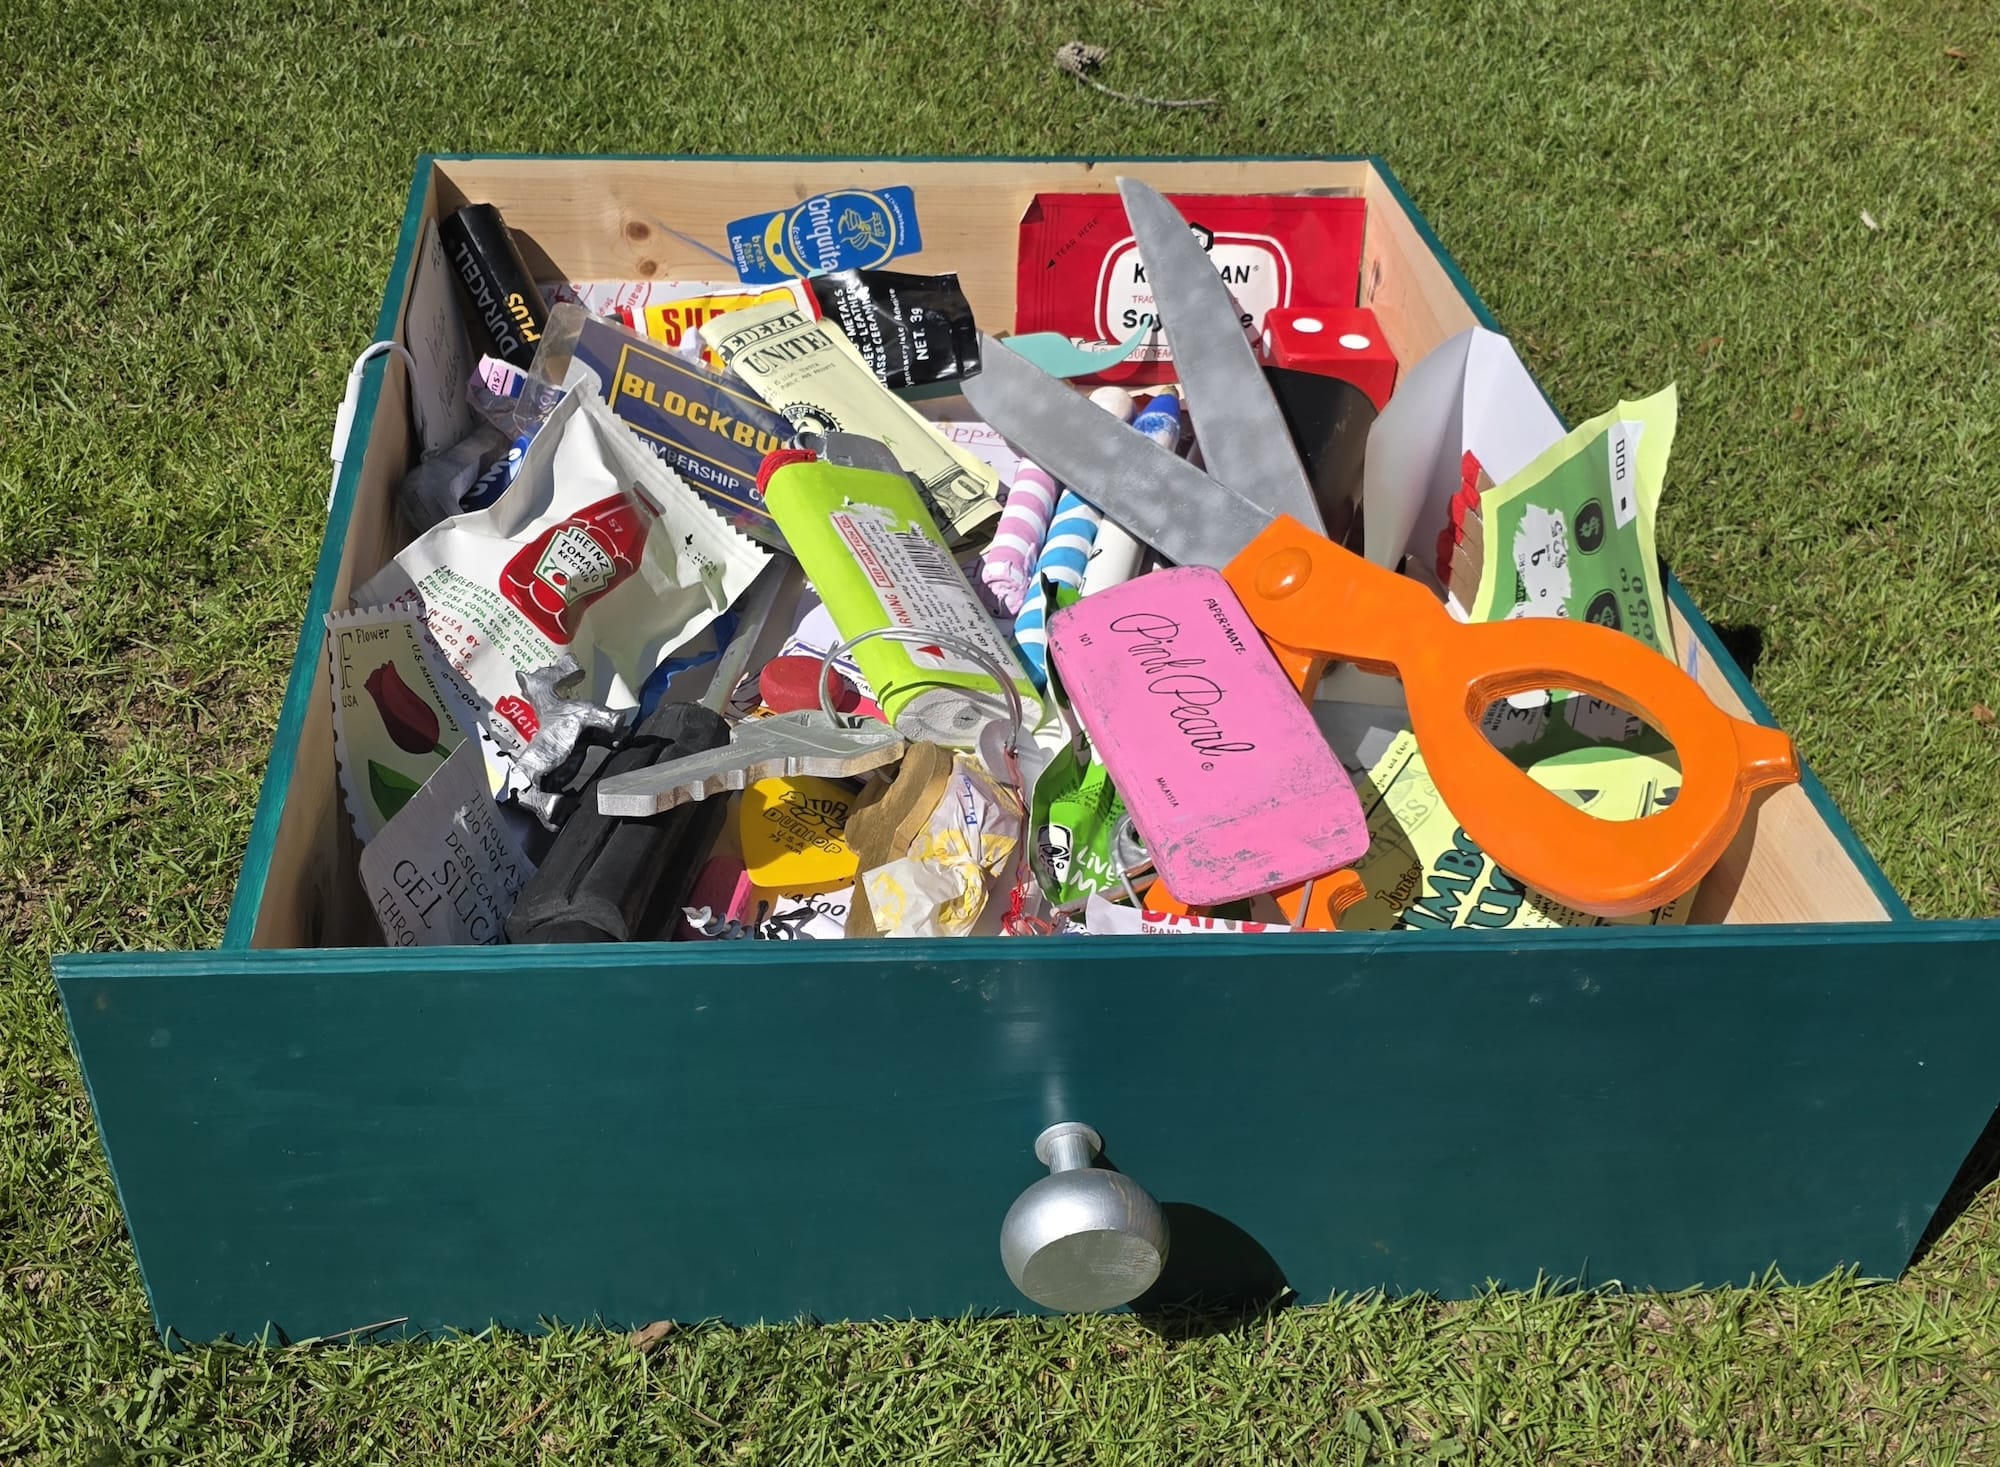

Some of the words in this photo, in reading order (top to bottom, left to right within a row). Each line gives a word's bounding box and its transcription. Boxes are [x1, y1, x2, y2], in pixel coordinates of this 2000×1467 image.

[732, 235, 749, 273] banana
[806, 198, 838, 272] Chiquita
[1056, 237, 1077, 258] TEAR
[1078, 219, 1098, 238] HERE
[456, 242, 519, 358] DURACELL
[507, 293, 541, 343] PLUS
[834, 288, 857, 336] METALS
[743, 328, 833, 377] UNITE
[912, 328, 929, 361] NET.
[622, 372, 787, 457] BLOCKBU
[639, 436, 740, 490] EMBERSHIP
[561, 538, 599, 583] TOMATO
[574, 533, 610, 571] HEINZ
[847, 529, 862, 548] FROM
[860, 549, 874, 567] AWAY
[557, 549, 591, 584] KETCHUP
[1618, 568, 1630, 593] to
[424, 575, 462, 603] FRUCTOSE
[465, 601, 487, 619] CORN
[513, 644, 534, 664] CORN
[432, 568, 449, 585] RED
[514, 630, 546, 661] DISTILLED
[440, 565, 501, 605] INGREDIENTS:
[504, 605, 534, 635] TOMATO
[442, 600, 471, 619] ONION
[1629, 607, 1640, 636] up
[355, 627, 390, 644] Flower
[428, 607, 440, 616] IN
[466, 635, 480, 649] BY
[1079, 632, 1093, 648] 101
[1109, 613, 1207, 675] Pink
[342, 695, 358, 708] USA
[403, 623, 413, 639] For
[420, 665, 447, 712] addresses
[445, 712, 459, 733] only
[1147, 674, 1256, 757] Pearl
[1155, 776, 1180, 809] MALAYSIA
[464, 810, 480, 834] DO
[480, 836, 502, 873] NOT
[470, 790, 508, 857] THROW
[763, 807, 842, 855] DUNLOP
[393, 860, 442, 929] GEL
[445, 831, 503, 921] DESICCAN
[1375, 860, 1424, 910] Junior
